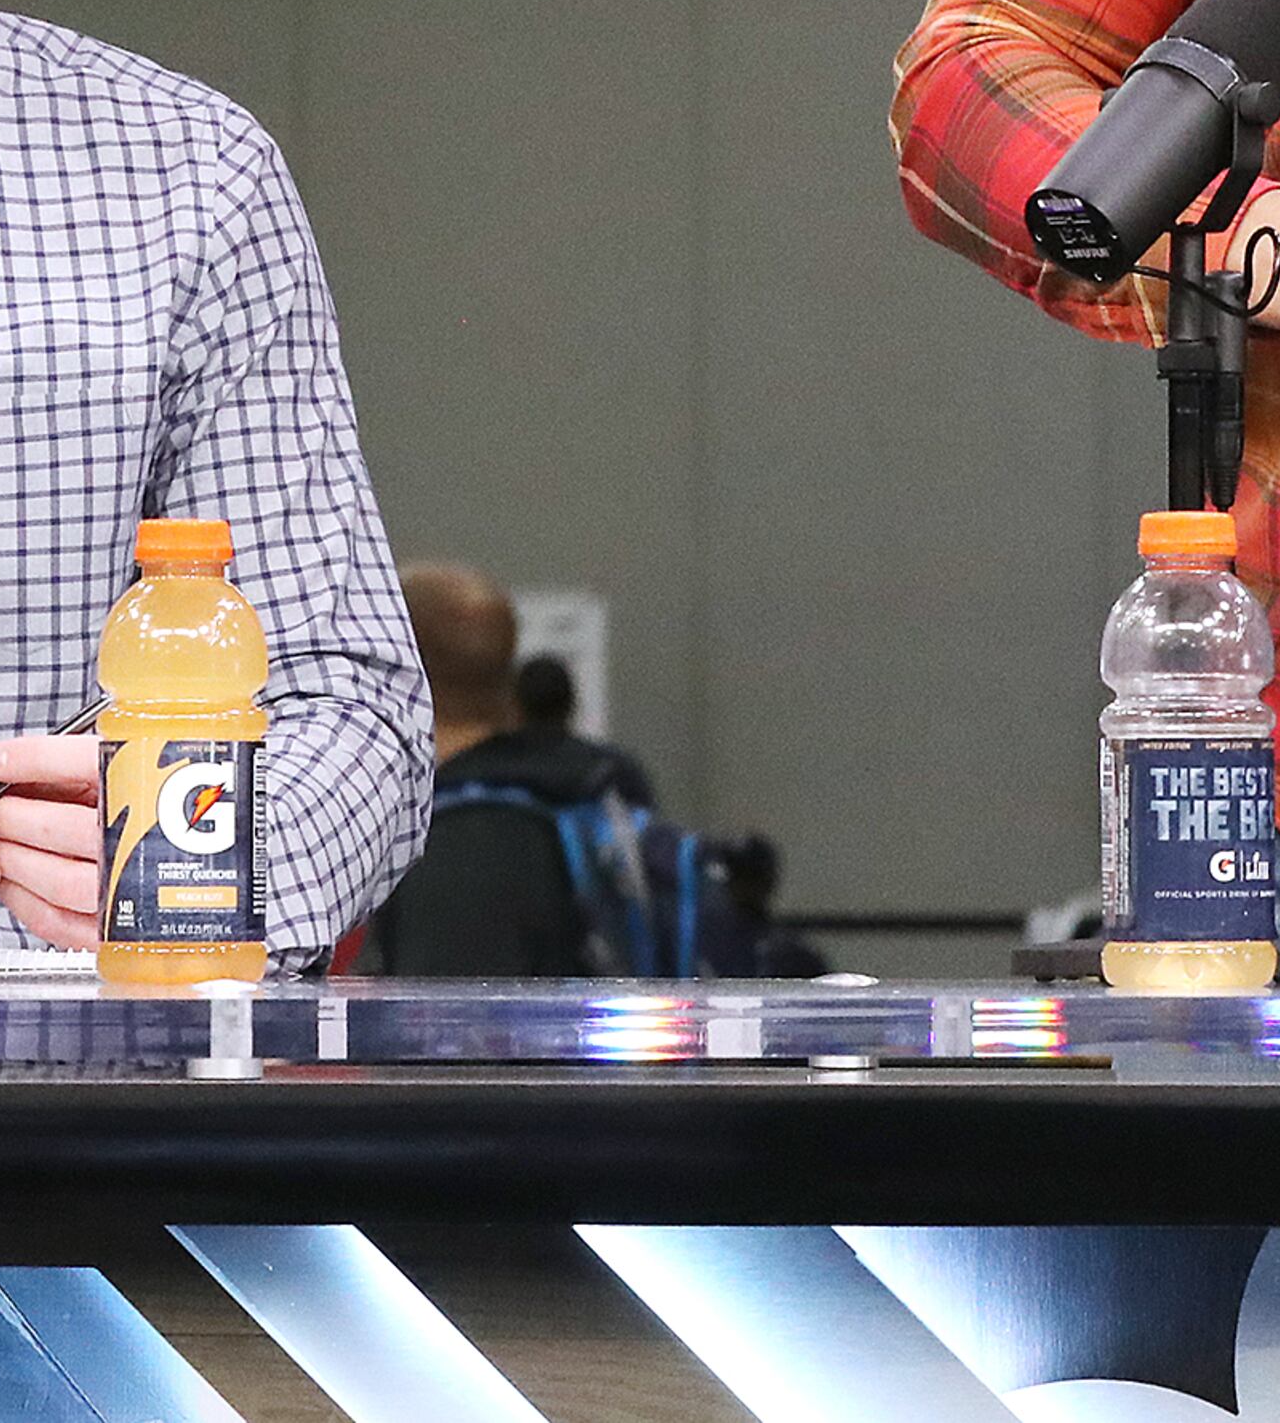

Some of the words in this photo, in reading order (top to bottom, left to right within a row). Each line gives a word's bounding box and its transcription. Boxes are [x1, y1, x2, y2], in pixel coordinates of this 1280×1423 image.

[1149, 767, 1207, 797] THE
[1213, 767, 1267, 797] BEST
[157, 761, 237, 855] G
[1151, 800, 1230, 841] THE
[158, 869, 191, 880] THIRST
[1154, 889, 1193, 899] OFFICIAL
[1195, 889, 1227, 899] SPORTS
